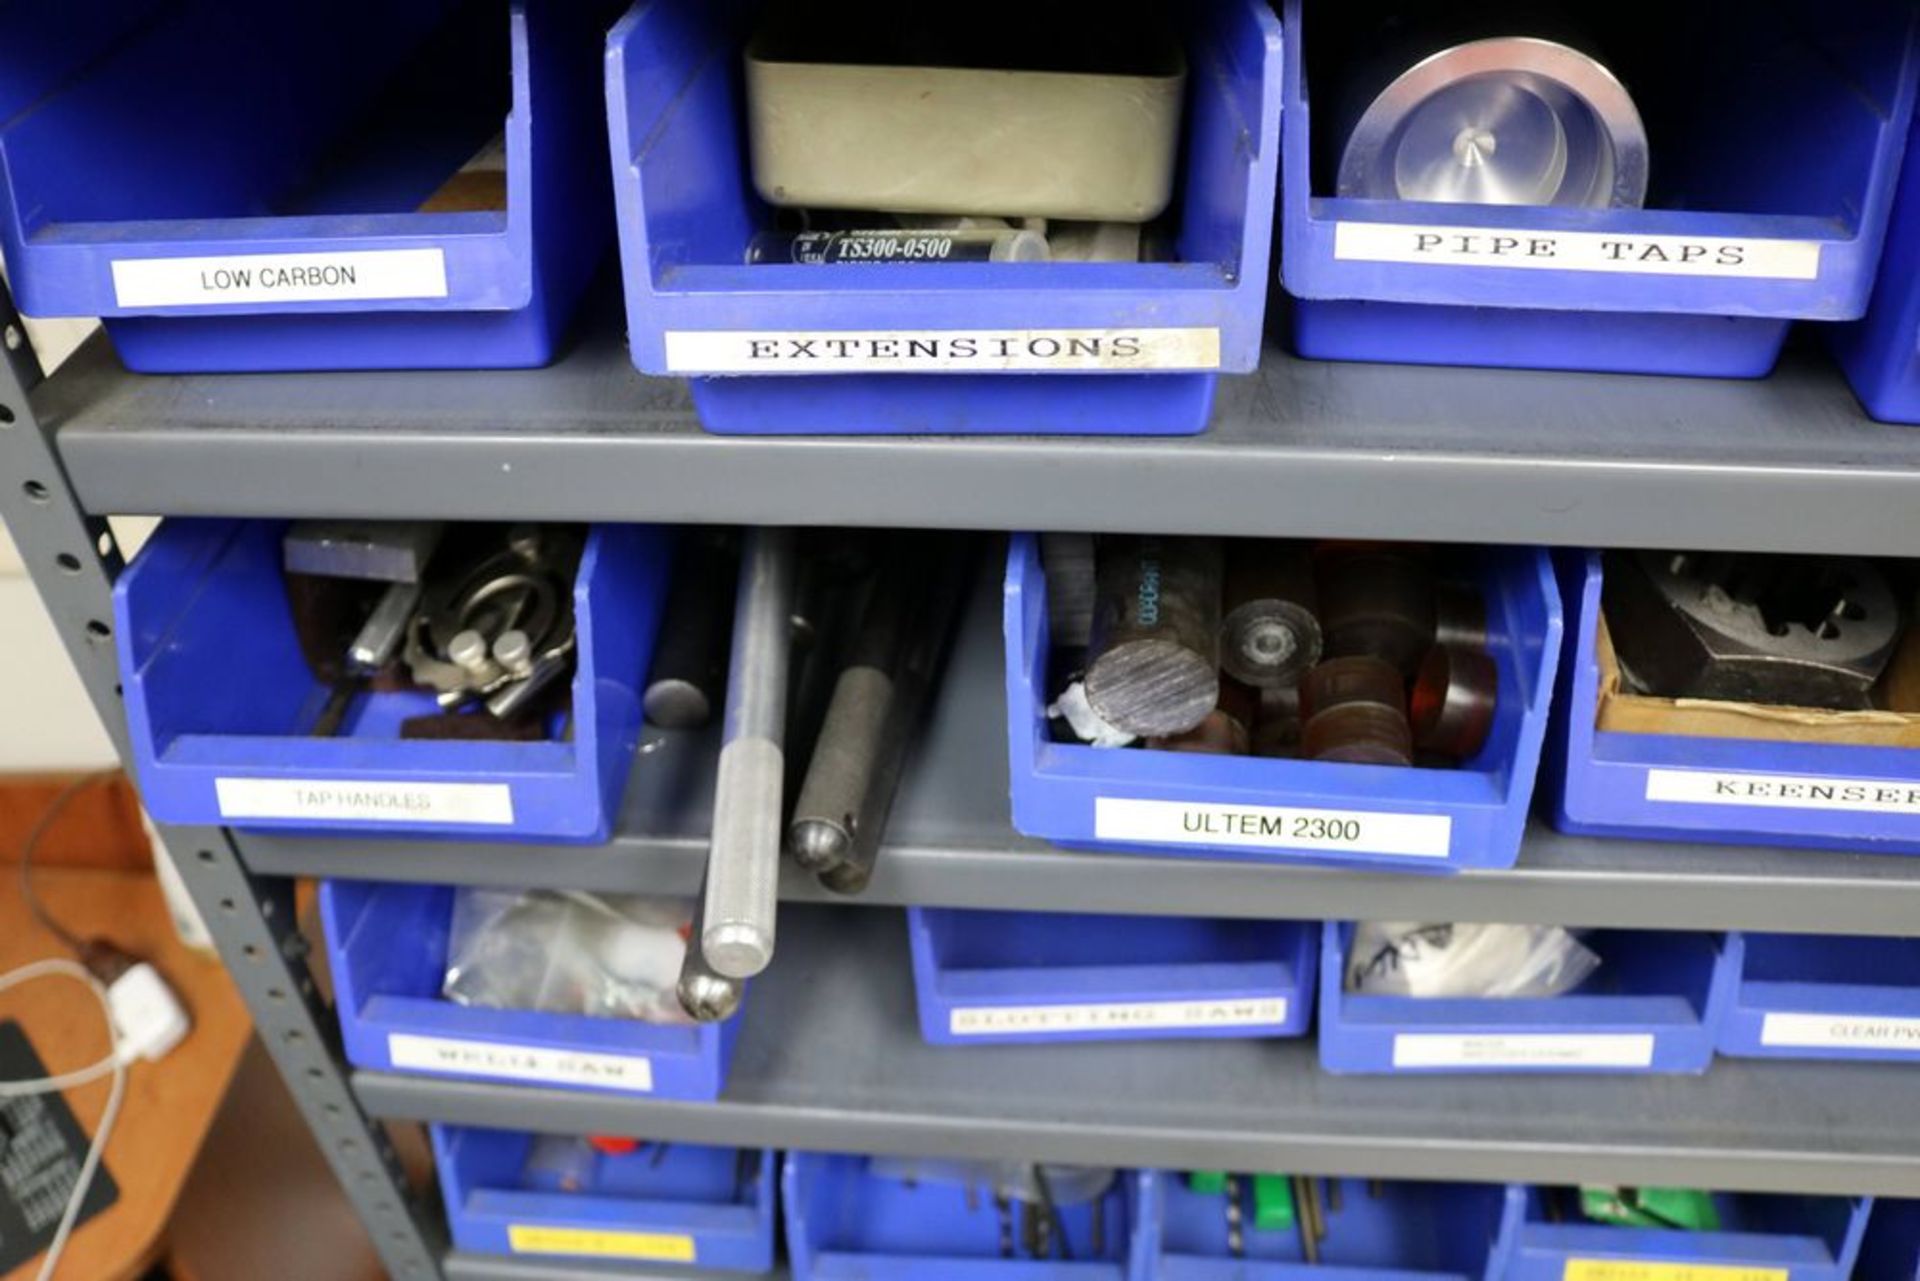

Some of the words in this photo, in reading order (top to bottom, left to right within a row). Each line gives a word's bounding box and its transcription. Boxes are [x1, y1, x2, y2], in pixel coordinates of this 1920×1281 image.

[837, 238, 953, 259] TS300-0500
[1411, 233, 1557, 258] PIPE
[1600, 241, 1746, 267] TAPS
[201, 269, 252, 291] LOW
[259, 264, 357, 289] CARBON
[746, 335, 1143, 361] EXTENSIONS
[296, 789, 333, 807] TAP
[338, 791, 432, 811] HANDLES
[1182, 811, 1283, 837] ULTEM
[1291, 816, 1361, 842] 2300
[1829, 1022, 1890, 1040] CLEAR
